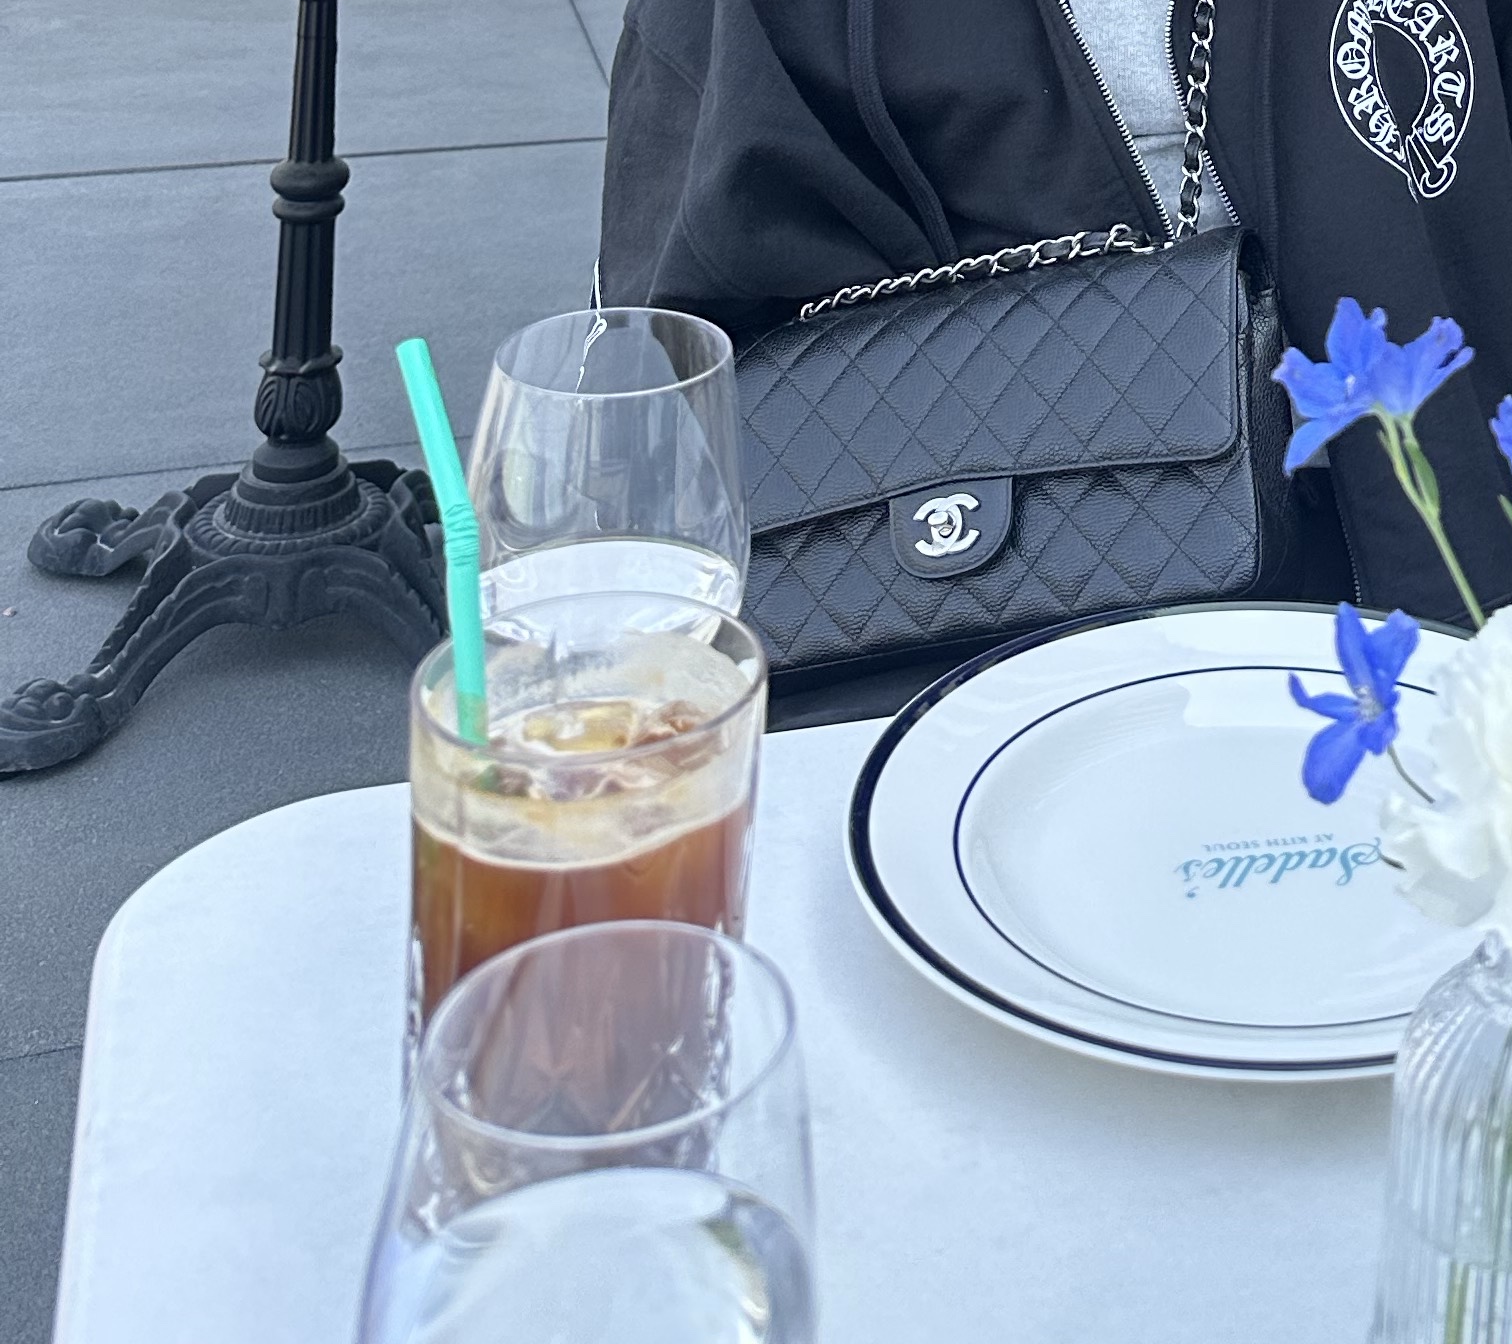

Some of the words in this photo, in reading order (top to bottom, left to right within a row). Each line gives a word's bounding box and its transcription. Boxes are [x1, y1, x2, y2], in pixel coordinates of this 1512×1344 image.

[1265, 835, 1308, 847] KITH
[1314, 832, 1334, 843] AT
[1201, 839, 1261, 853] SEOUL
[1174, 836, 1382, 899] Sadelle's
